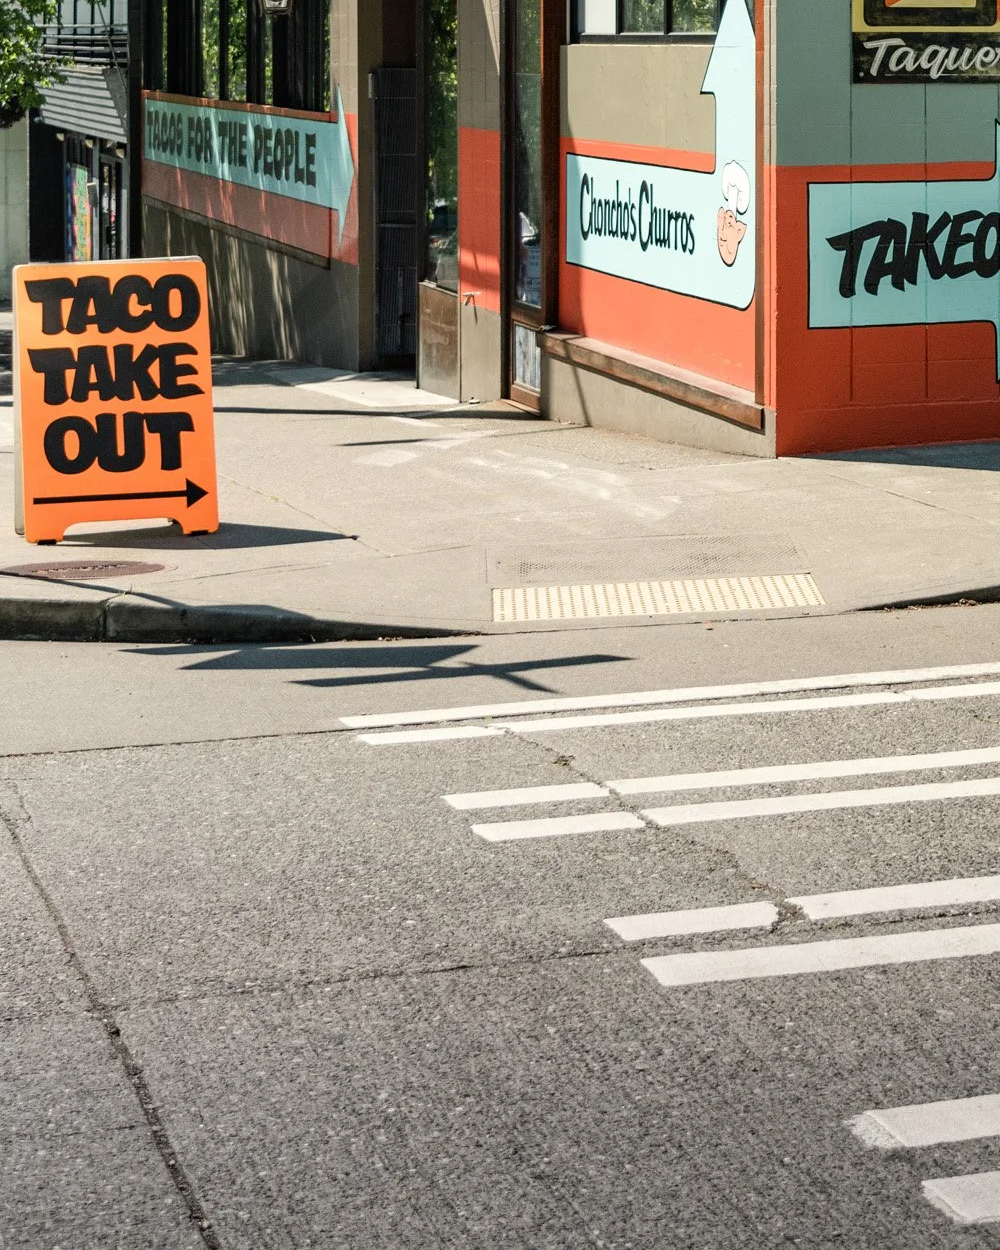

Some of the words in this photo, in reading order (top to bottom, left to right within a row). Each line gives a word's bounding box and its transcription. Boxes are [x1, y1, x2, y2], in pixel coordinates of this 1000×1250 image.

[147, 110, 183, 158] TACOS
[188, 116, 213, 164] FOR
[218, 121, 248, 168] THE
[253, 124, 317, 188] PEOPLE
[638, 179, 696, 256] Churros
[24, 274, 201, 335] TACO
[27, 342, 206, 406] TAKE
[43, 411, 195, 475] OUT
